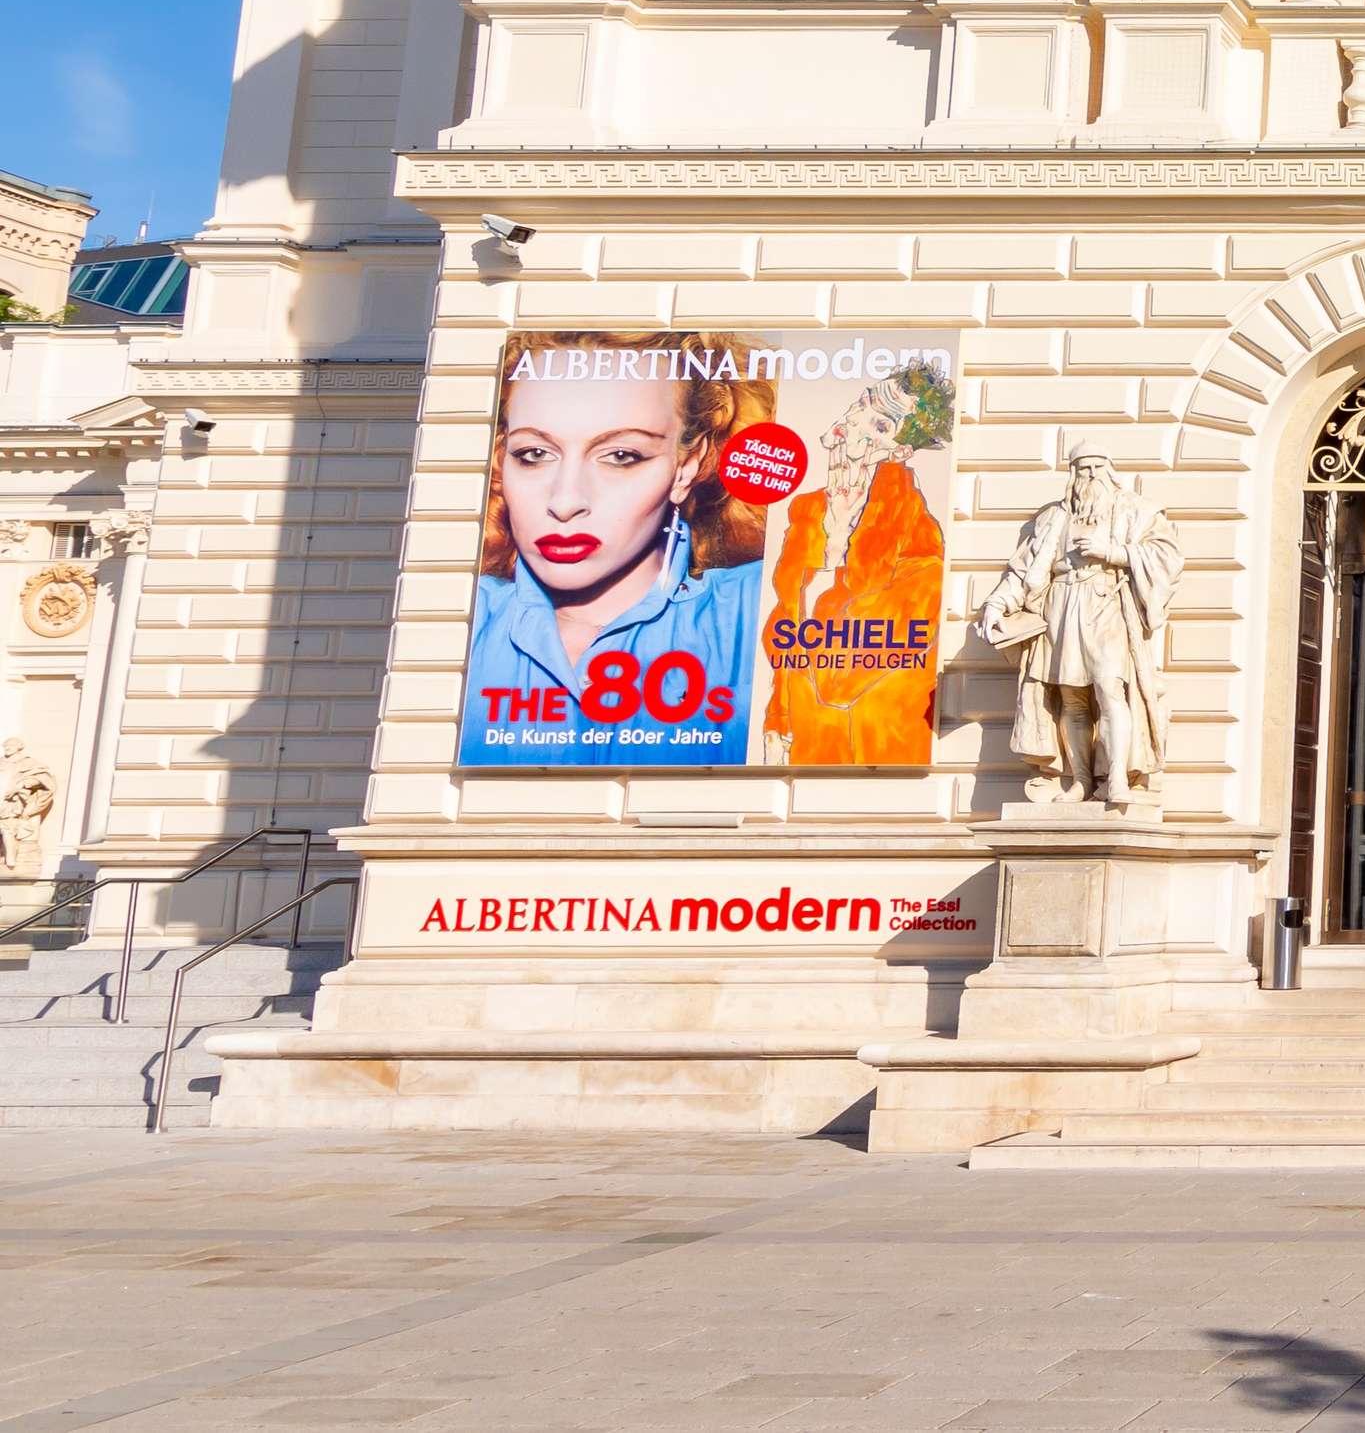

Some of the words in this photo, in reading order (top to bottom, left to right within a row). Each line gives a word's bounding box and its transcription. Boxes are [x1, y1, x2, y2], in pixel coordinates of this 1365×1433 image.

[508, 349, 741, 382] ALBERTINA
[747, 338, 952, 381] modern
[744, 438, 796, 463] TÄGLICH
[729, 451, 798, 479] GEÖFFNET!
[764, 476, 792, 493] UHR
[772, 619, 930, 650] SCHIELE
[770, 653, 811, 669] UND
[816, 653, 846, 669] DIE
[852, 653, 927, 669] FOLGEN
[480, 687, 570, 723] THE
[485, 728, 516, 745] Die
[521, 728, 575, 745] Kunst
[581, 728, 614, 745] der
[618, 728, 665, 745] 80er
[669, 728, 724, 745] Jahre
[419, 897, 662, 933] ALBERTINA
[668, 886, 883, 933] modern
[890, 897, 922, 913] The
[926, 897, 961, 913] Essl
[889, 915, 977, 931] Collection
